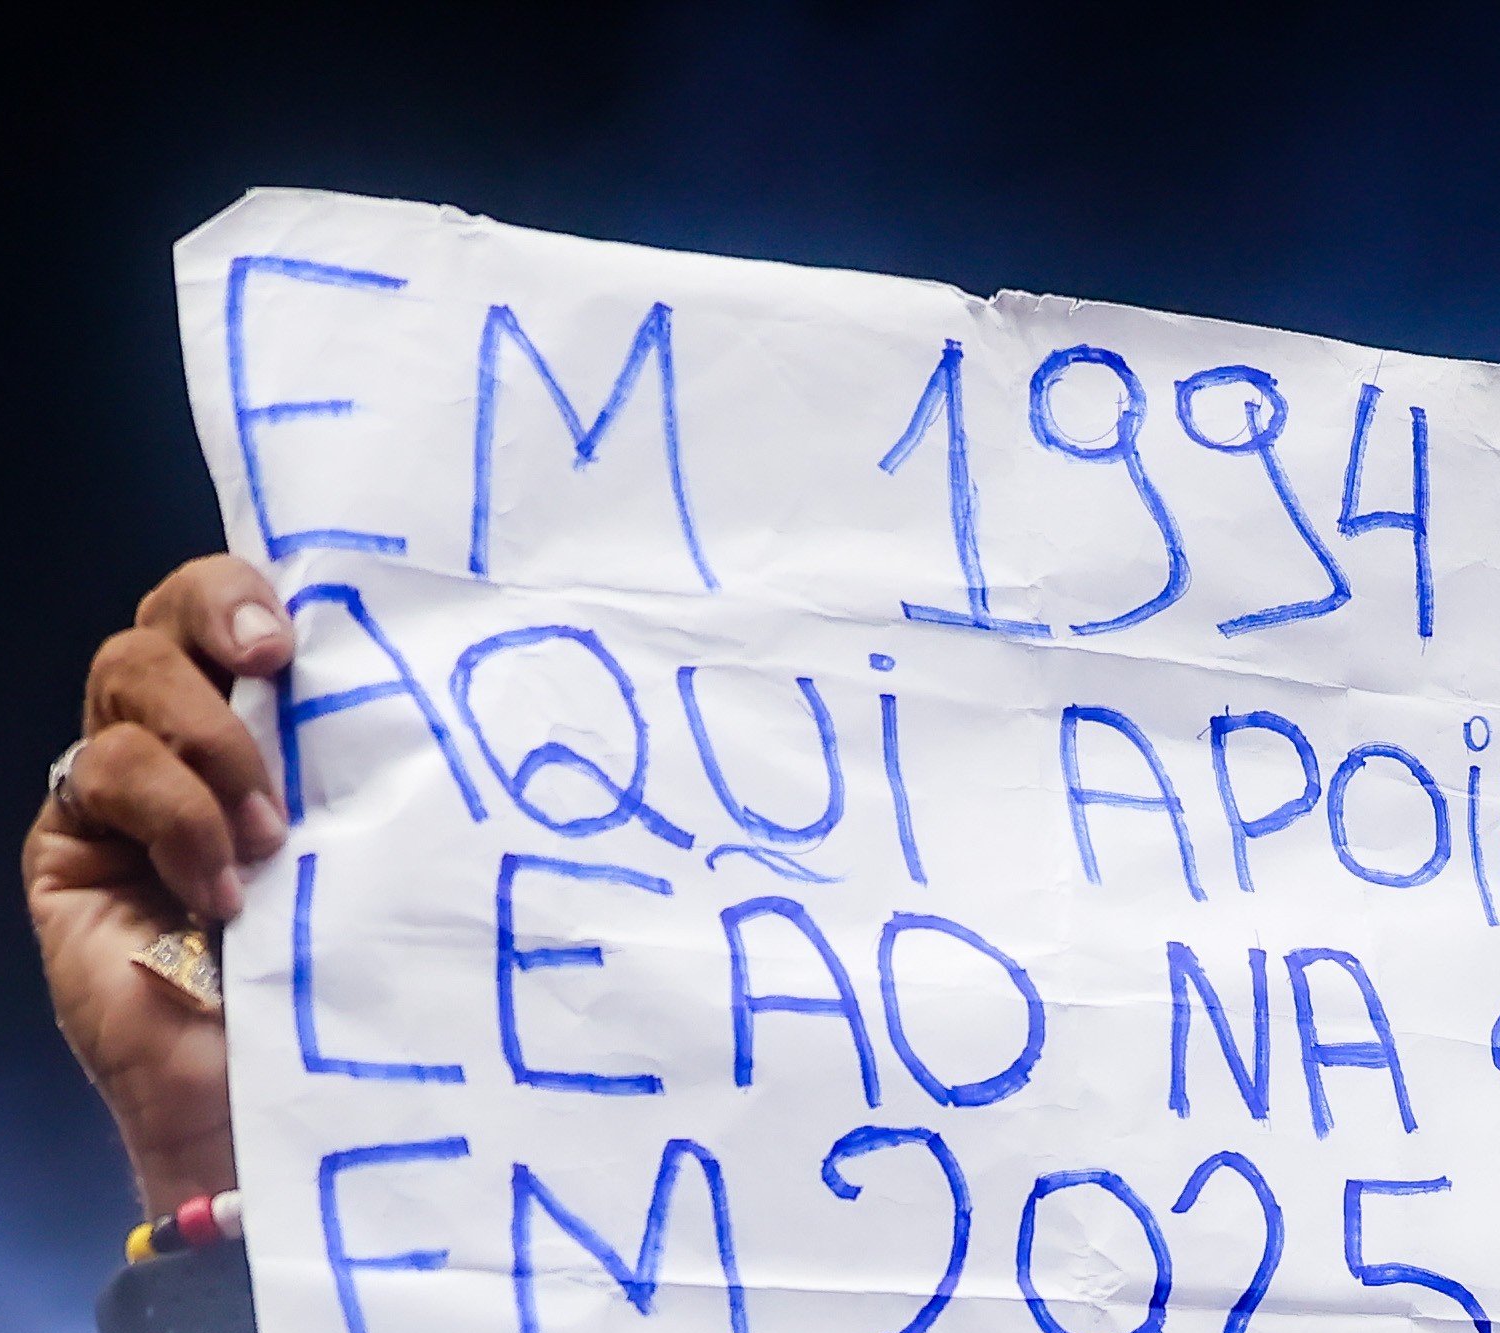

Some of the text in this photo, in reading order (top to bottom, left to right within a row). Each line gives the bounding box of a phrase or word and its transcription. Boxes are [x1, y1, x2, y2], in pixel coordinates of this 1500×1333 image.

[226, 256, 722, 590] EM
[879, 339, 1434, 639] 1994
[292, 845, 1045, 1109] LEÃO
[1168, 942, 1417, 1138] NA
